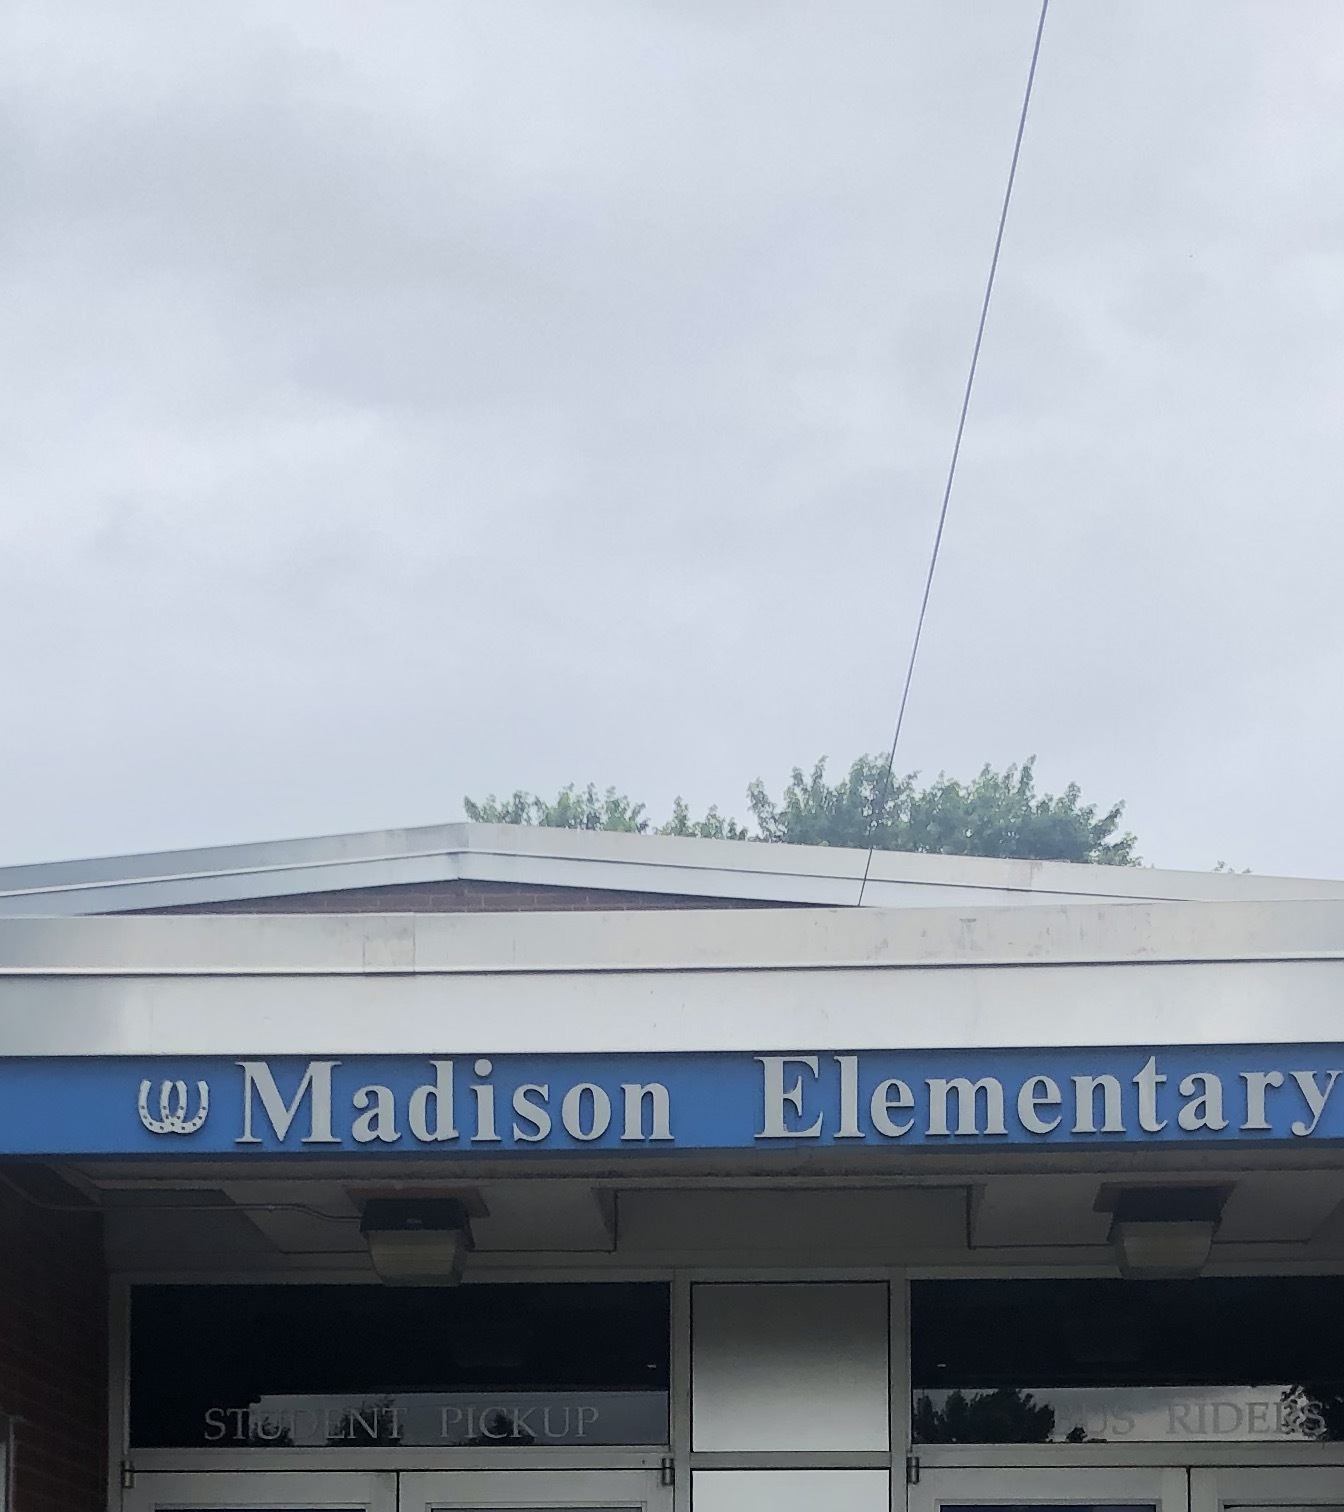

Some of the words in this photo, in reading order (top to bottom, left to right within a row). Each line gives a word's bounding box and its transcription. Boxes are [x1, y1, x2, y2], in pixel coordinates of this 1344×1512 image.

[234, 1058, 676, 1144] Madison
[753, 1054, 1343, 1139] Elementary
[203, 1406, 407, 1441] STUDENT
[440, 1405, 600, 1439] PICKUP
[1165, 1401, 1328, 1440] RIDERS
